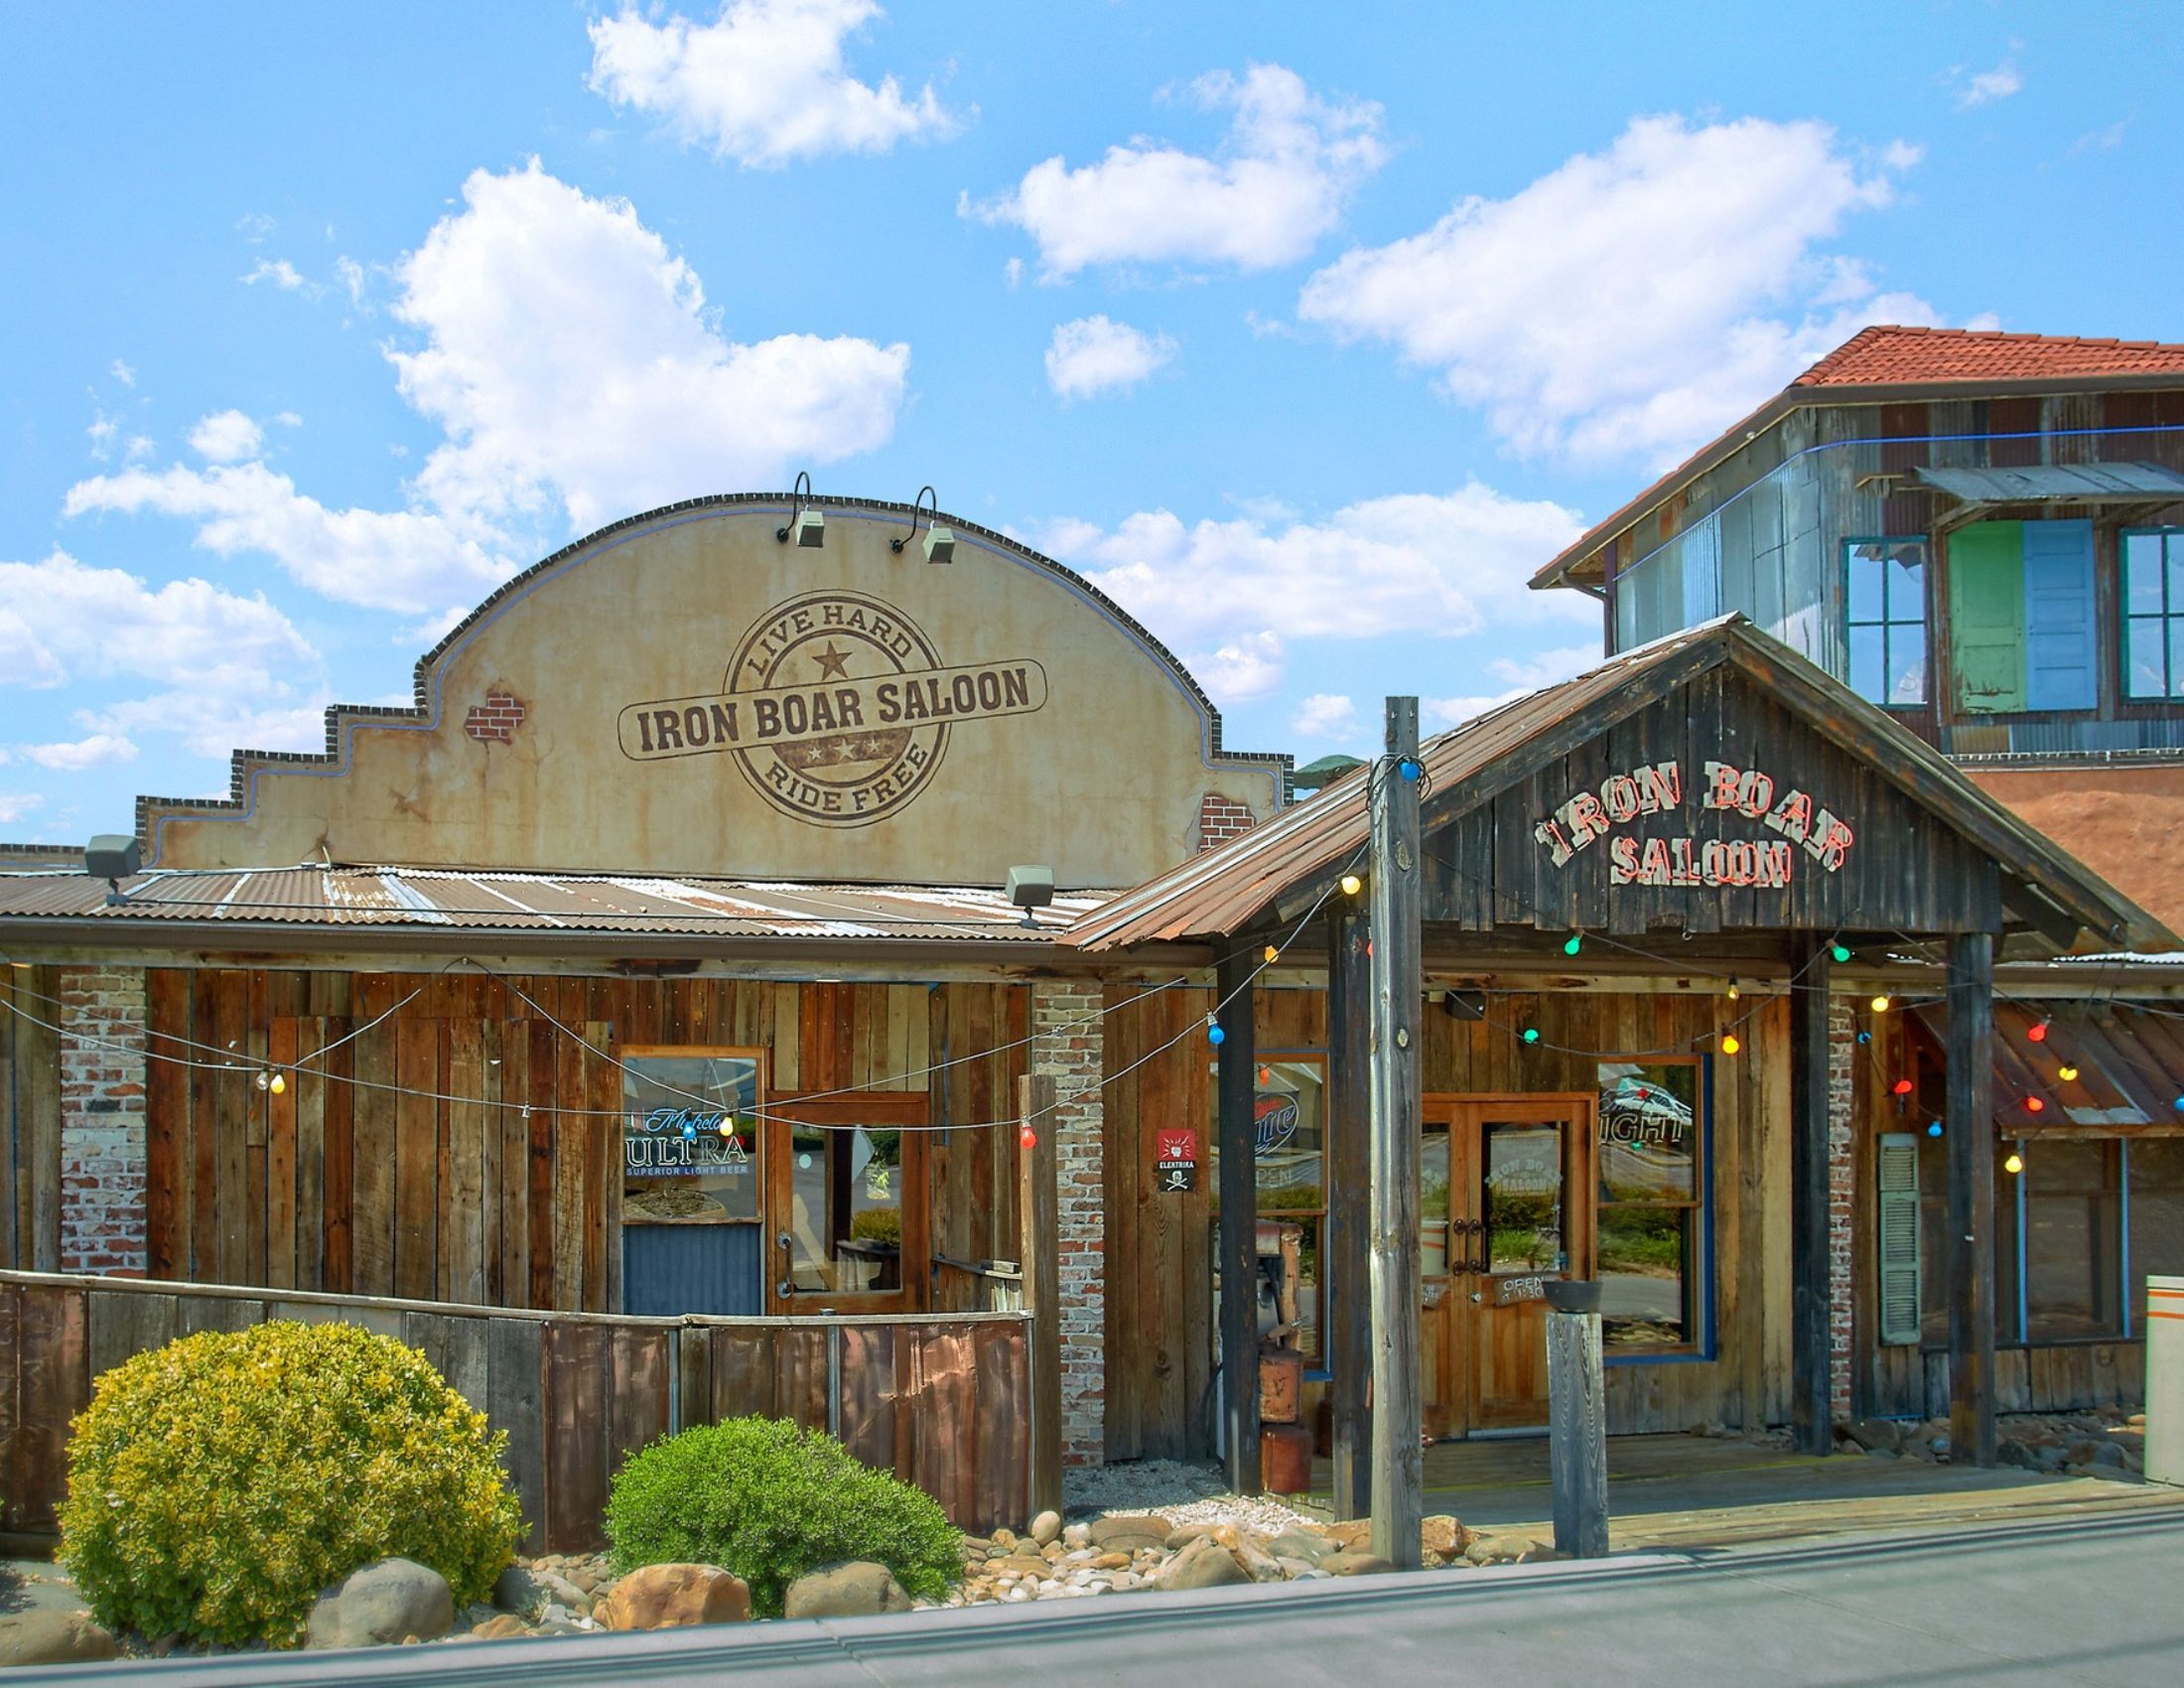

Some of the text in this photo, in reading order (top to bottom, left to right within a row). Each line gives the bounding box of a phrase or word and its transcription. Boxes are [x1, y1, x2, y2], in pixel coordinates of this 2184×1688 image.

[748, 605, 912, 676] LIVE HARD
[636, 667, 1030, 752] IRON BOAR SALOON
[765, 743, 928, 812] RIDE FREE
[1535, 761, 1853, 872] IRON BOAR
[1610, 836, 1792, 889] SALOON
[625, 1136, 749, 1167] ULTRA
[1599, 1112, 1683, 1144] IGHT
[626, 1165, 749, 1177] SUPERIOR LIGHT BEER
[1503, 1276, 1545, 1291] OPEN
